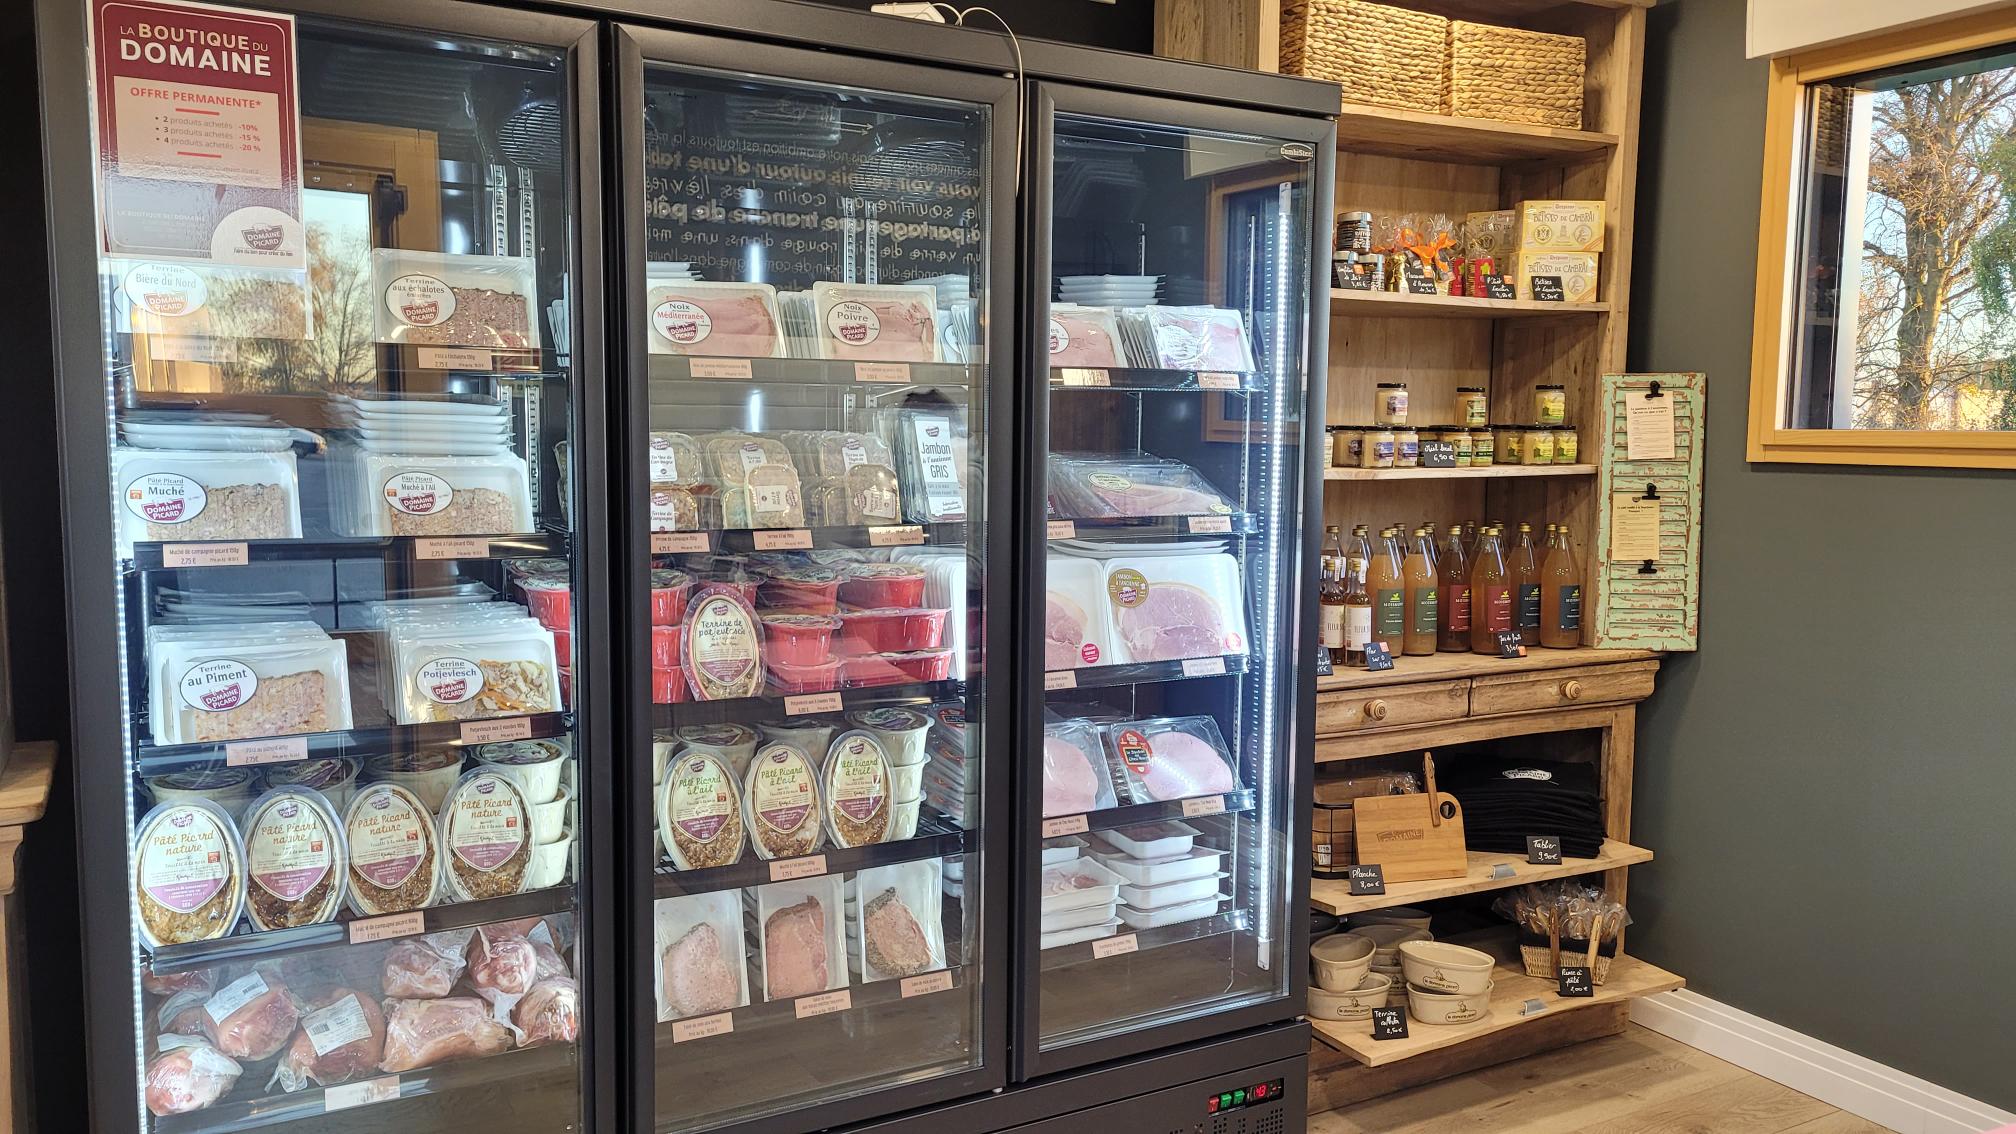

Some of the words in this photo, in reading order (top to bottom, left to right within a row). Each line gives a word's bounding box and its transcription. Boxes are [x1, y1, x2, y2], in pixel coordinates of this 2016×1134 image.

[120, 25, 136, 36] LA
[138, 22, 250, 51] BOUTIQUE
[252, 41, 268, 52] DU
[120, 38, 272, 77] DOMAINE
[130, 86, 169, 100] OFFRE
[163, 115, 169, 123] 2
[170, 116, 202, 128] produits
[203, 119, 233, 130] achetés
[238, 123, 258, 132] -10%
[163, 126, 169, 134] 3
[170, 127, 202, 139] produits
[203, 130, 233, 141] achetés
[170, 138, 203, 150] produits
[204, 141, 234, 151] achetés
[1533, 211, 1559, 223] BÊTISES
[1569, 210, 1595, 223] CAMBRAI
[247, 231, 281, 242] DOMAINE
[252, 238, 279, 248] PICARD
[1528, 262, 1553, 273] BÊTISES
[1563, 262, 1588, 273] CAMBRAI
[136, 273, 159, 284] Bière
[161, 274, 173, 286] du
[175, 276, 197, 288] Nord
[408, 284, 446, 294] échalotes
[150, 296, 185, 305] DOMAINE
[154, 302, 183, 311] PICARD
[406, 306, 438, 317] DOMAINE
[843, 303, 863, 312] Noix
[410, 312, 435, 322] PICARD
[656, 311, 705, 320] Méditerranée
[836, 312, 870, 322] Poivre
[669, 326, 698, 336] DOMAINE
[674, 332, 695, 340] PICARD
[842, 326, 868, 336] DOMAINE
[848, 332, 866, 340] PICARD
[921, 442, 952, 455] Jambon
[930, 464, 950, 478] GRIS
[148, 486, 185, 496] Muché
[403, 496, 434, 506] DOMAINE
[408, 502, 432, 511] PICARD
[147, 504, 182, 515] DOMAINE
[152, 510, 180, 520] PICARD
[199, 662, 232, 674] Terrine
[187, 676, 202, 688] au
[206, 670, 248, 684] Piment
[423, 670, 477, 680] Potjevlesch
[435, 682, 465, 694] DOMAINE
[206, 688, 238, 704] DOMAINE
[440, 689, 466, 700] PICARD
[212, 696, 238, 709] PICARD
[761, 769, 778, 780] Pâté
[779, 766, 804, 777] Picard
[696, 774, 722, 786] Picard
[461, 800, 482, 811] Pâté
[483, 798, 512, 808] Picard
[471, 808, 502, 818] nature
[357, 817, 379, 830] Pâté
[381, 812, 412, 826] Picard
[261, 826, 284, 837] Pâté
[286, 821, 318, 834] Picard
[370, 822, 402, 835] nature
[154, 834, 177, 847] Pâté
[180, 830, 214, 844] Picard
[1532, 838, 1556, 850] Tablier
[166, 842, 202, 856] nature
[1352, 868, 1378, 879] Planche
